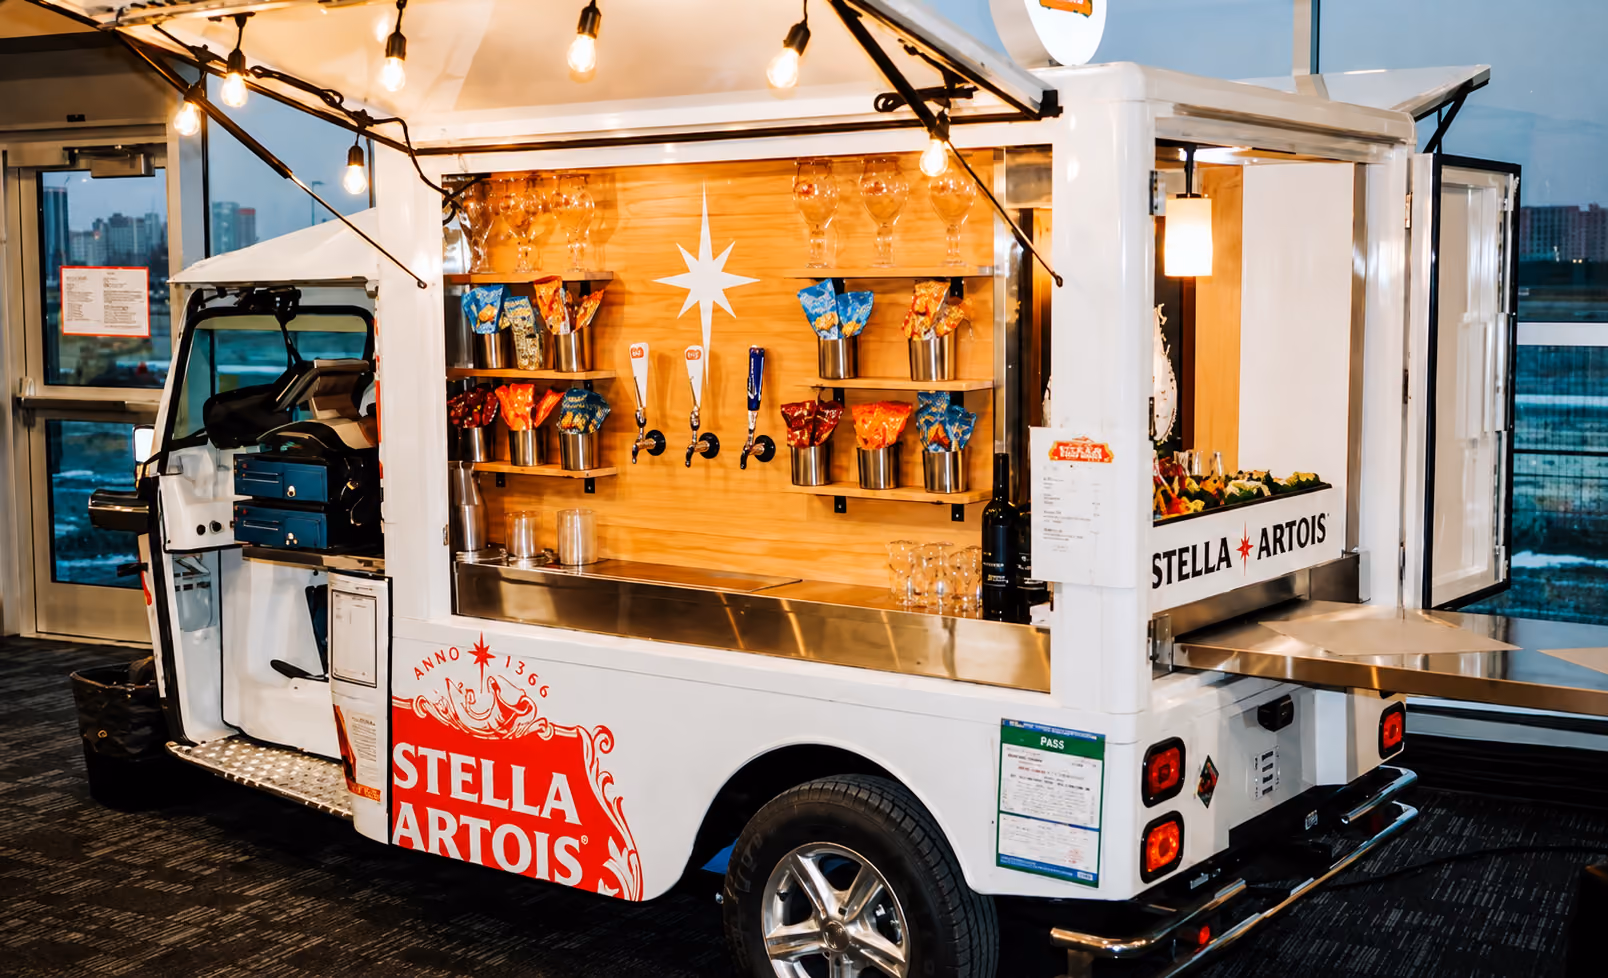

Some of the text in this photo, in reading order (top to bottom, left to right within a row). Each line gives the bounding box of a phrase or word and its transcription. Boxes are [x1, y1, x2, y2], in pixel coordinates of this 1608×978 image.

[1152, 513, 1326, 589] STELLA ARTOIS
[413, 646, 550, 698] ANNO 1366
[1040, 736, 1065, 750] PASS
[393, 742, 582, 826] STELLA
